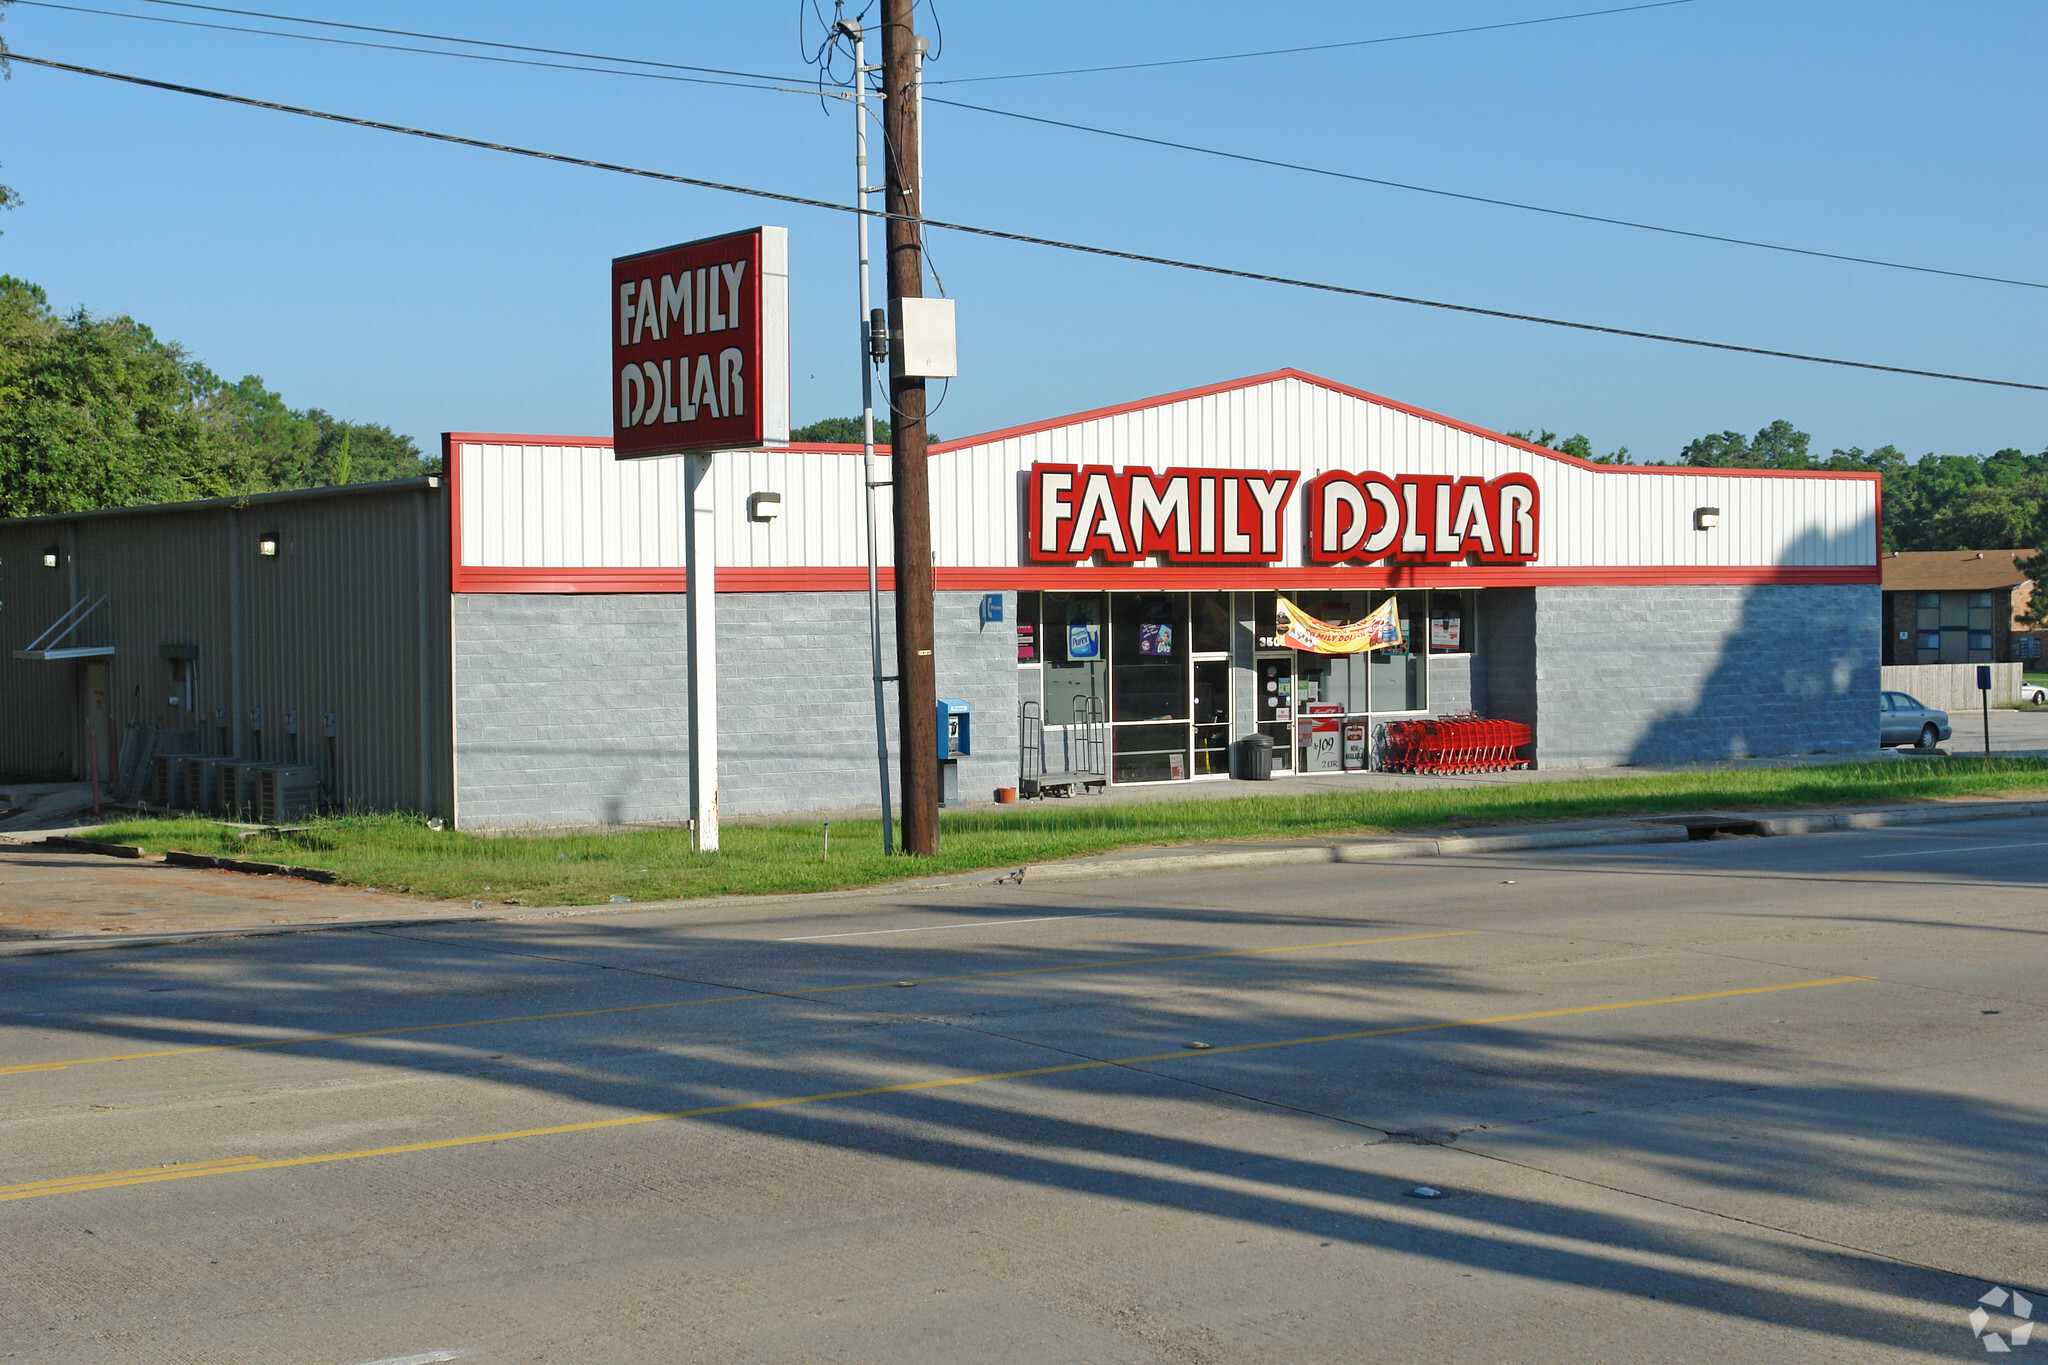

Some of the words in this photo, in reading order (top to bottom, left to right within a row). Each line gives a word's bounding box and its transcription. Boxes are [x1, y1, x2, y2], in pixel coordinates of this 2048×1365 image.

[620, 260, 747, 346] FAMILY
[621, 347, 744, 428] DOLLAR
[1040, 472, 1291, 554] FAMILY
[1322, 480, 1534, 556] DOLLAR
[1072, 636, 1089, 648] Purex
[1259, 637, 1281, 647] 350
[1306, 629, 1338, 642] FAMILY
[1157, 641, 1171, 653] Luvs
